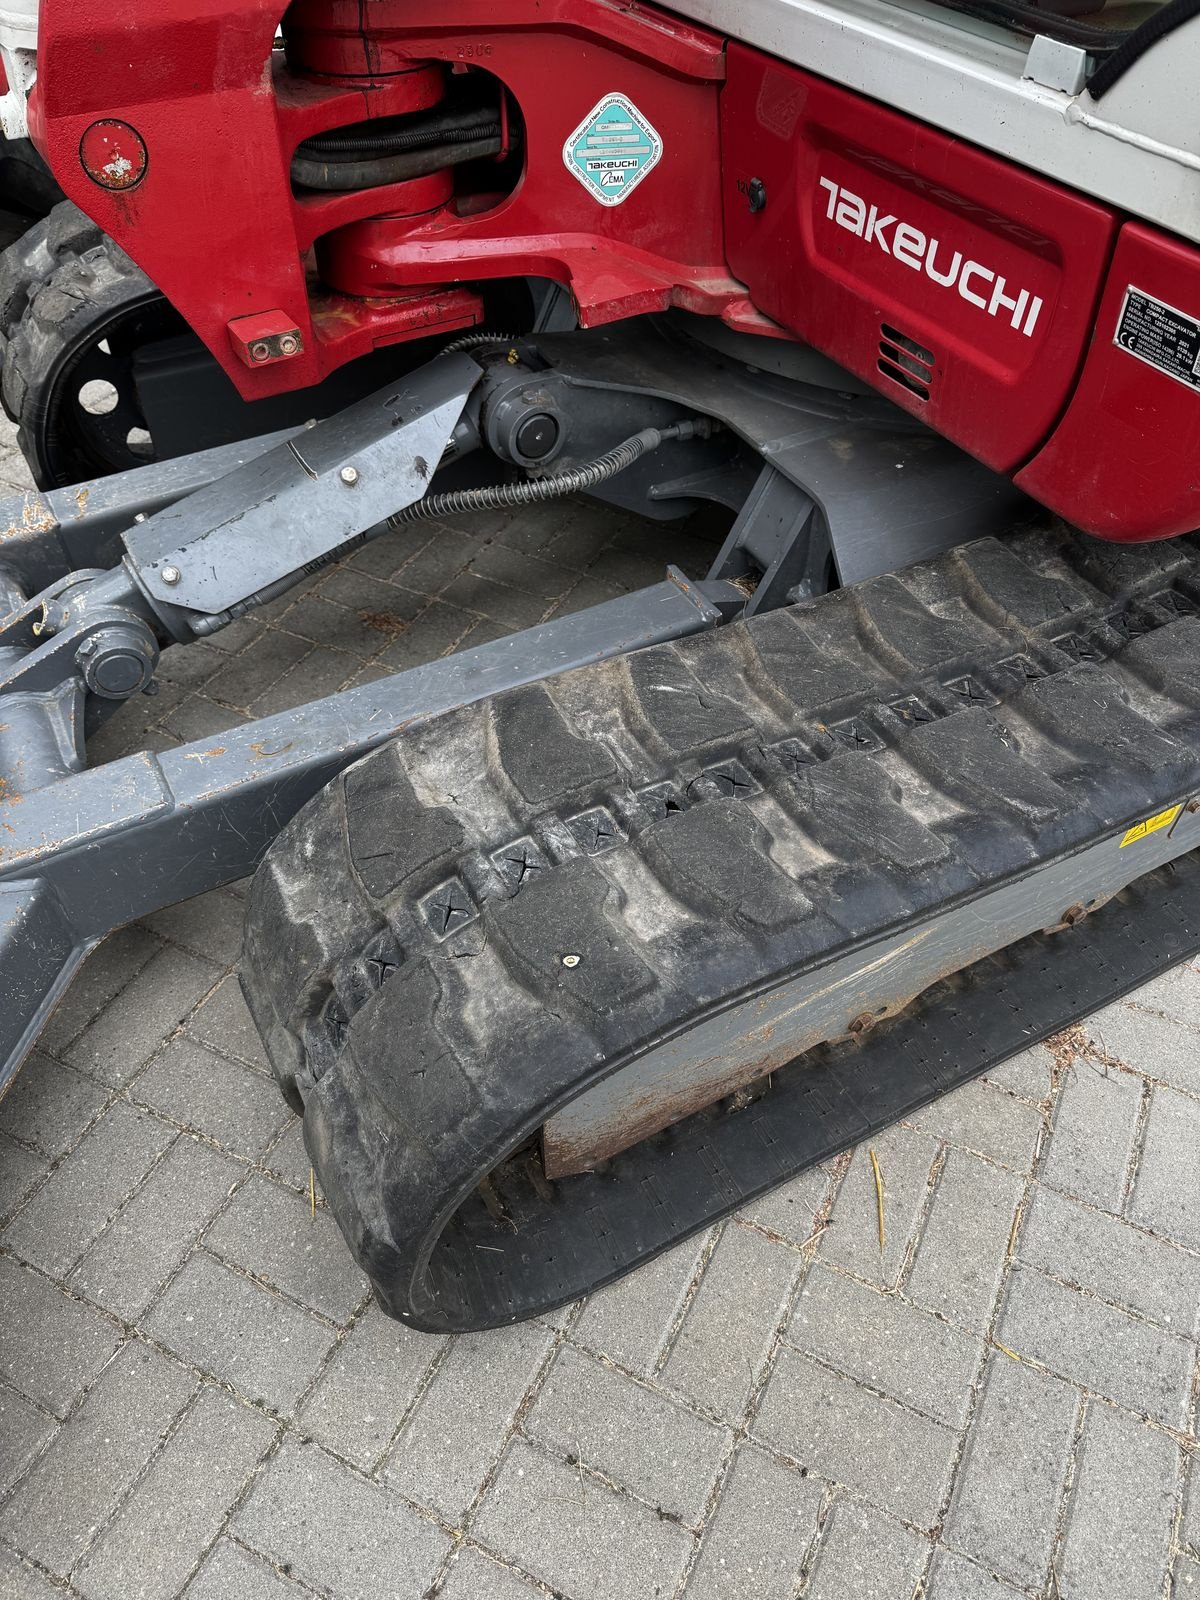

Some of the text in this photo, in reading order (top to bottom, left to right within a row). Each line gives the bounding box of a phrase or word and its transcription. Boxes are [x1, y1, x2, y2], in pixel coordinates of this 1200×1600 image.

[591, 112, 600, 122] New
[600, 98, 628, 112] Construction
[645, 128, 657, 143] Export
[819, 175, 1044, 338] TAKEUCHI
[1130, 300, 1141, 310] TYPE
[1146, 308, 1168, 324] COMPACT
[1168, 320, 1197, 338] EXCAVATOR
[1131, 294, 1147, 306] MODEL
